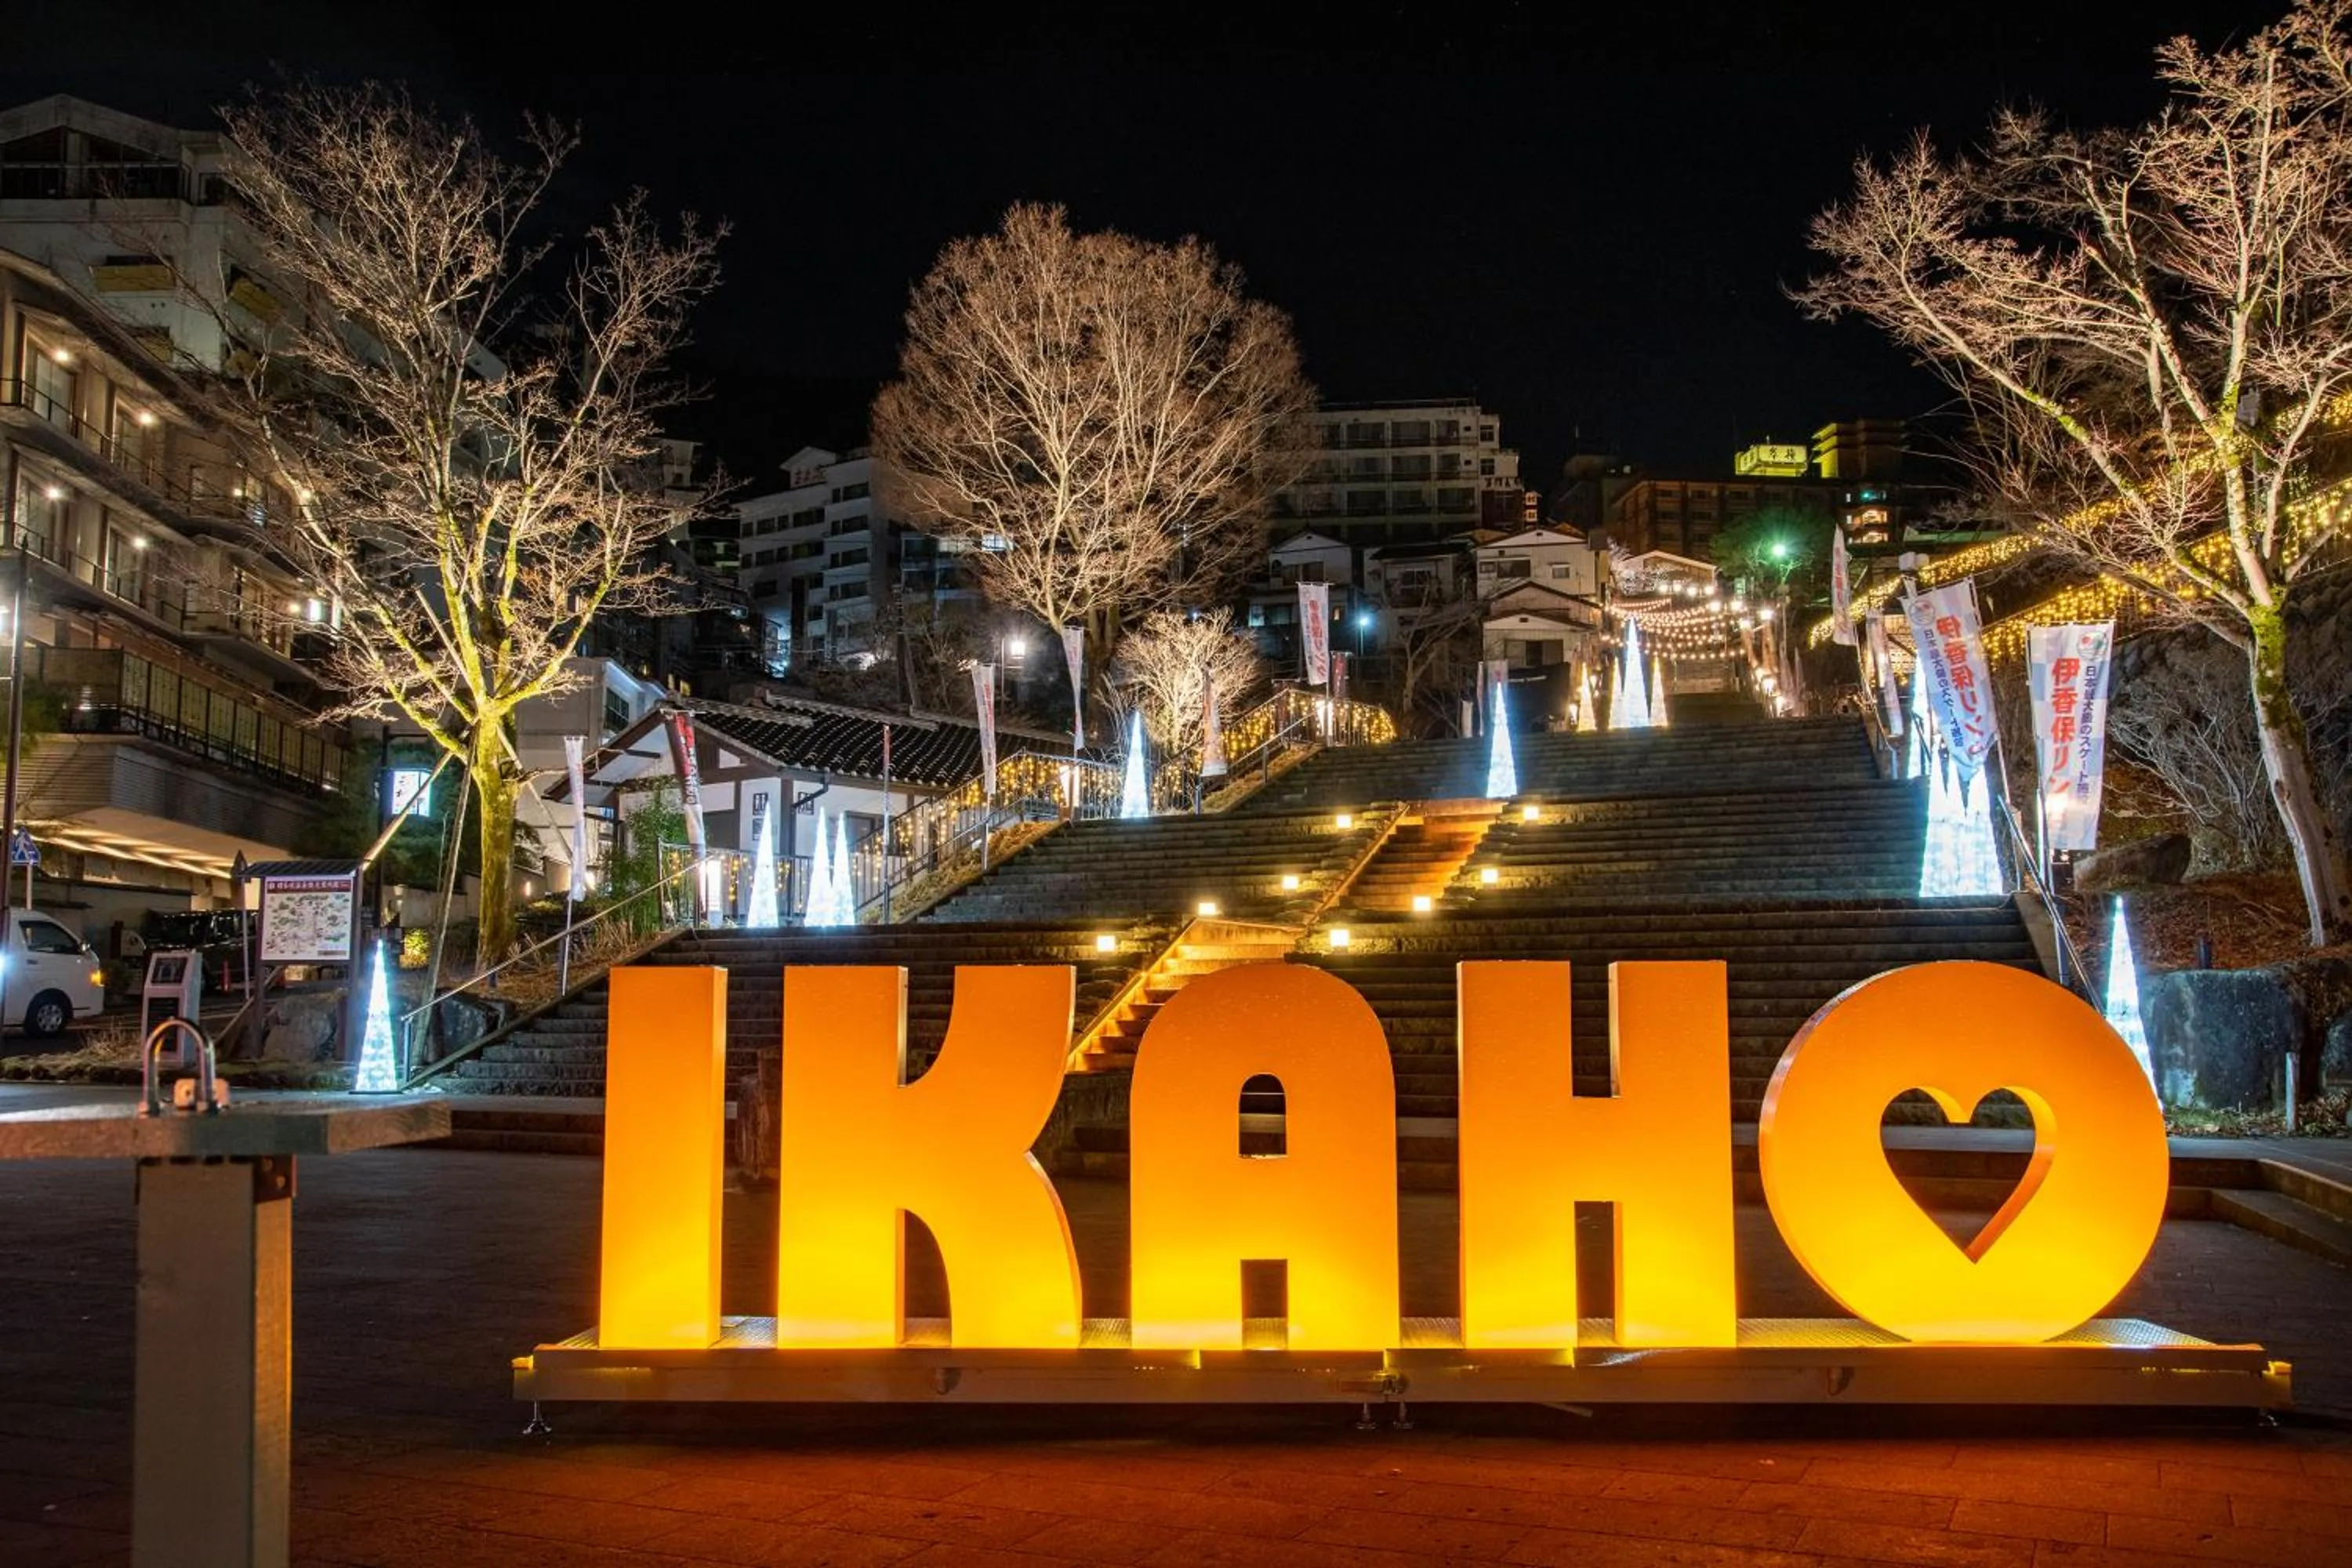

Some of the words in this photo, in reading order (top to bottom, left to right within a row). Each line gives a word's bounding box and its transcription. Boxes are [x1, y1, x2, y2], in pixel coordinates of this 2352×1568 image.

[2049, 658, 2080, 797] 伊香保リン
[598, 959, 2171, 1351] IKAHO
